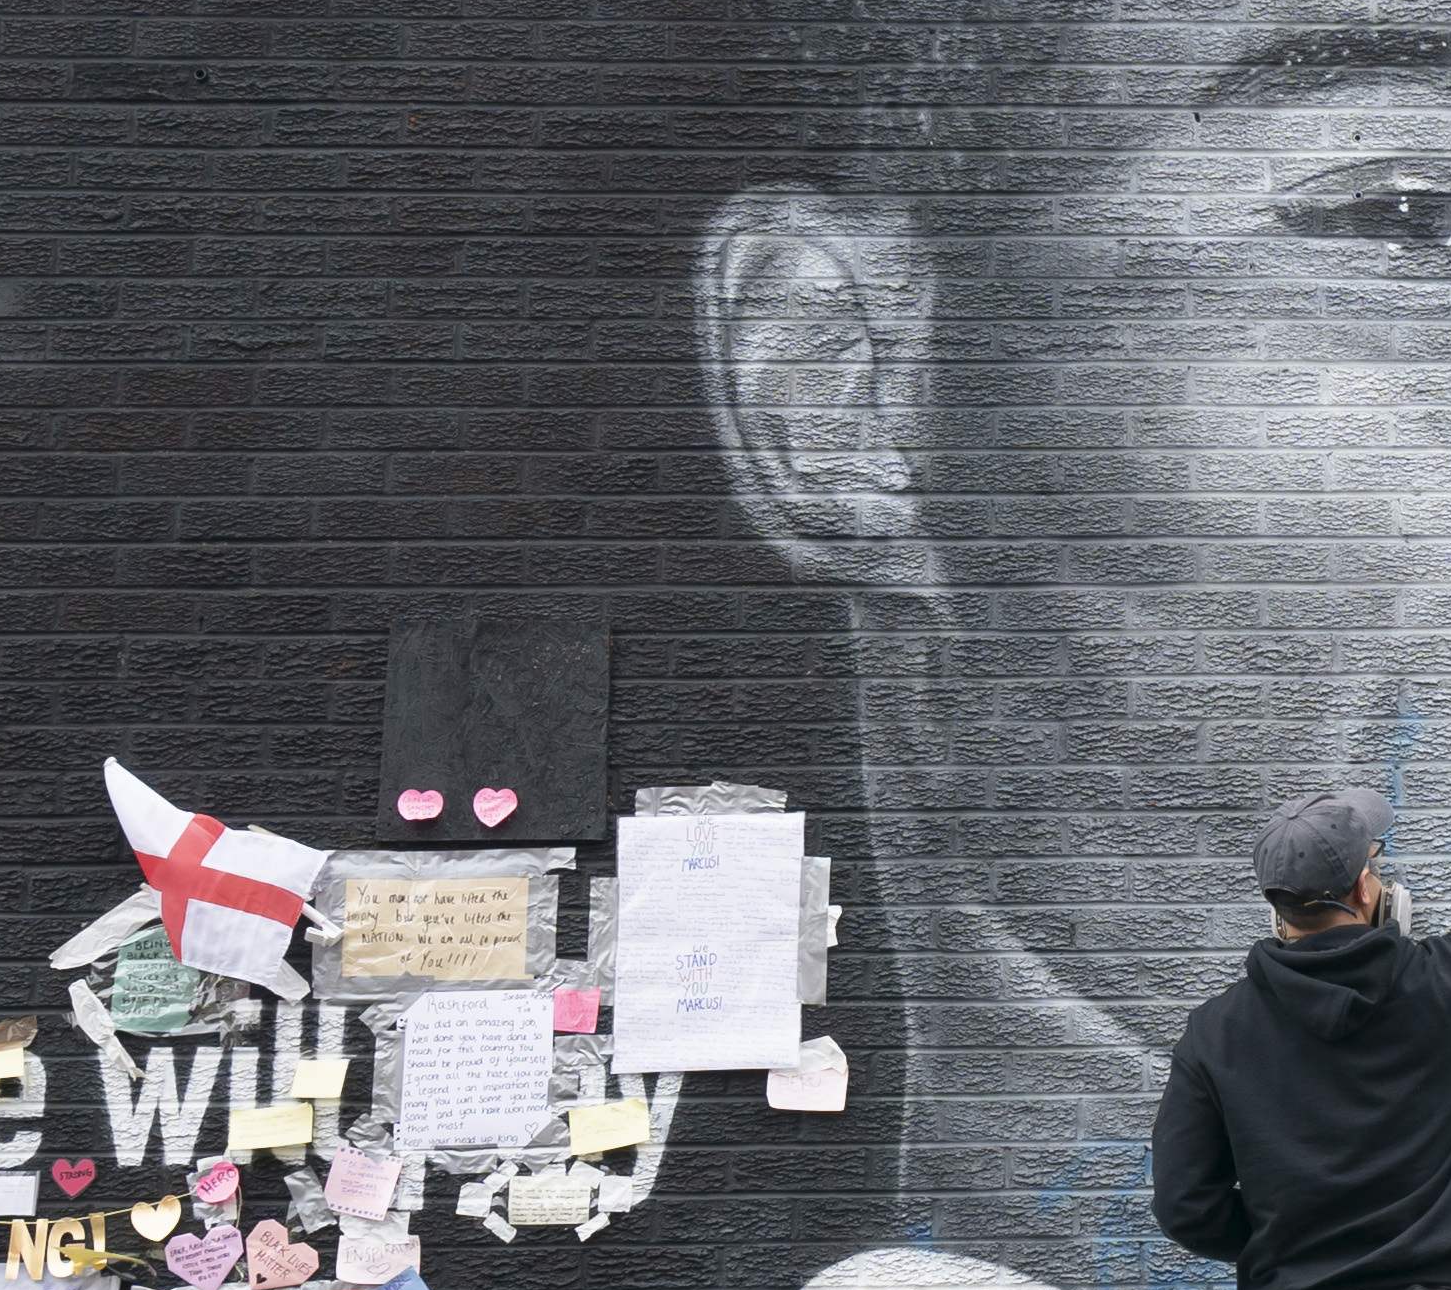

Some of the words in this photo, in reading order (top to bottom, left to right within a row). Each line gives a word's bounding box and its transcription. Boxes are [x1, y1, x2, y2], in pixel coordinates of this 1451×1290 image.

[685, 826, 718, 842] LOVE
[690, 841, 714, 856] YOU
[675, 952, 717, 968] STAND
[677, 966, 713, 981] WITH
[683, 980, 709, 995] YOU
[426, 994, 489, 1012] Rashford
[675, 996, 723, 1013] MARCUS!
[260, 1230, 290, 1257] BLACK
[288, 1252, 312, 1276] LIVES
[254, 1249, 291, 1280] MATTER
